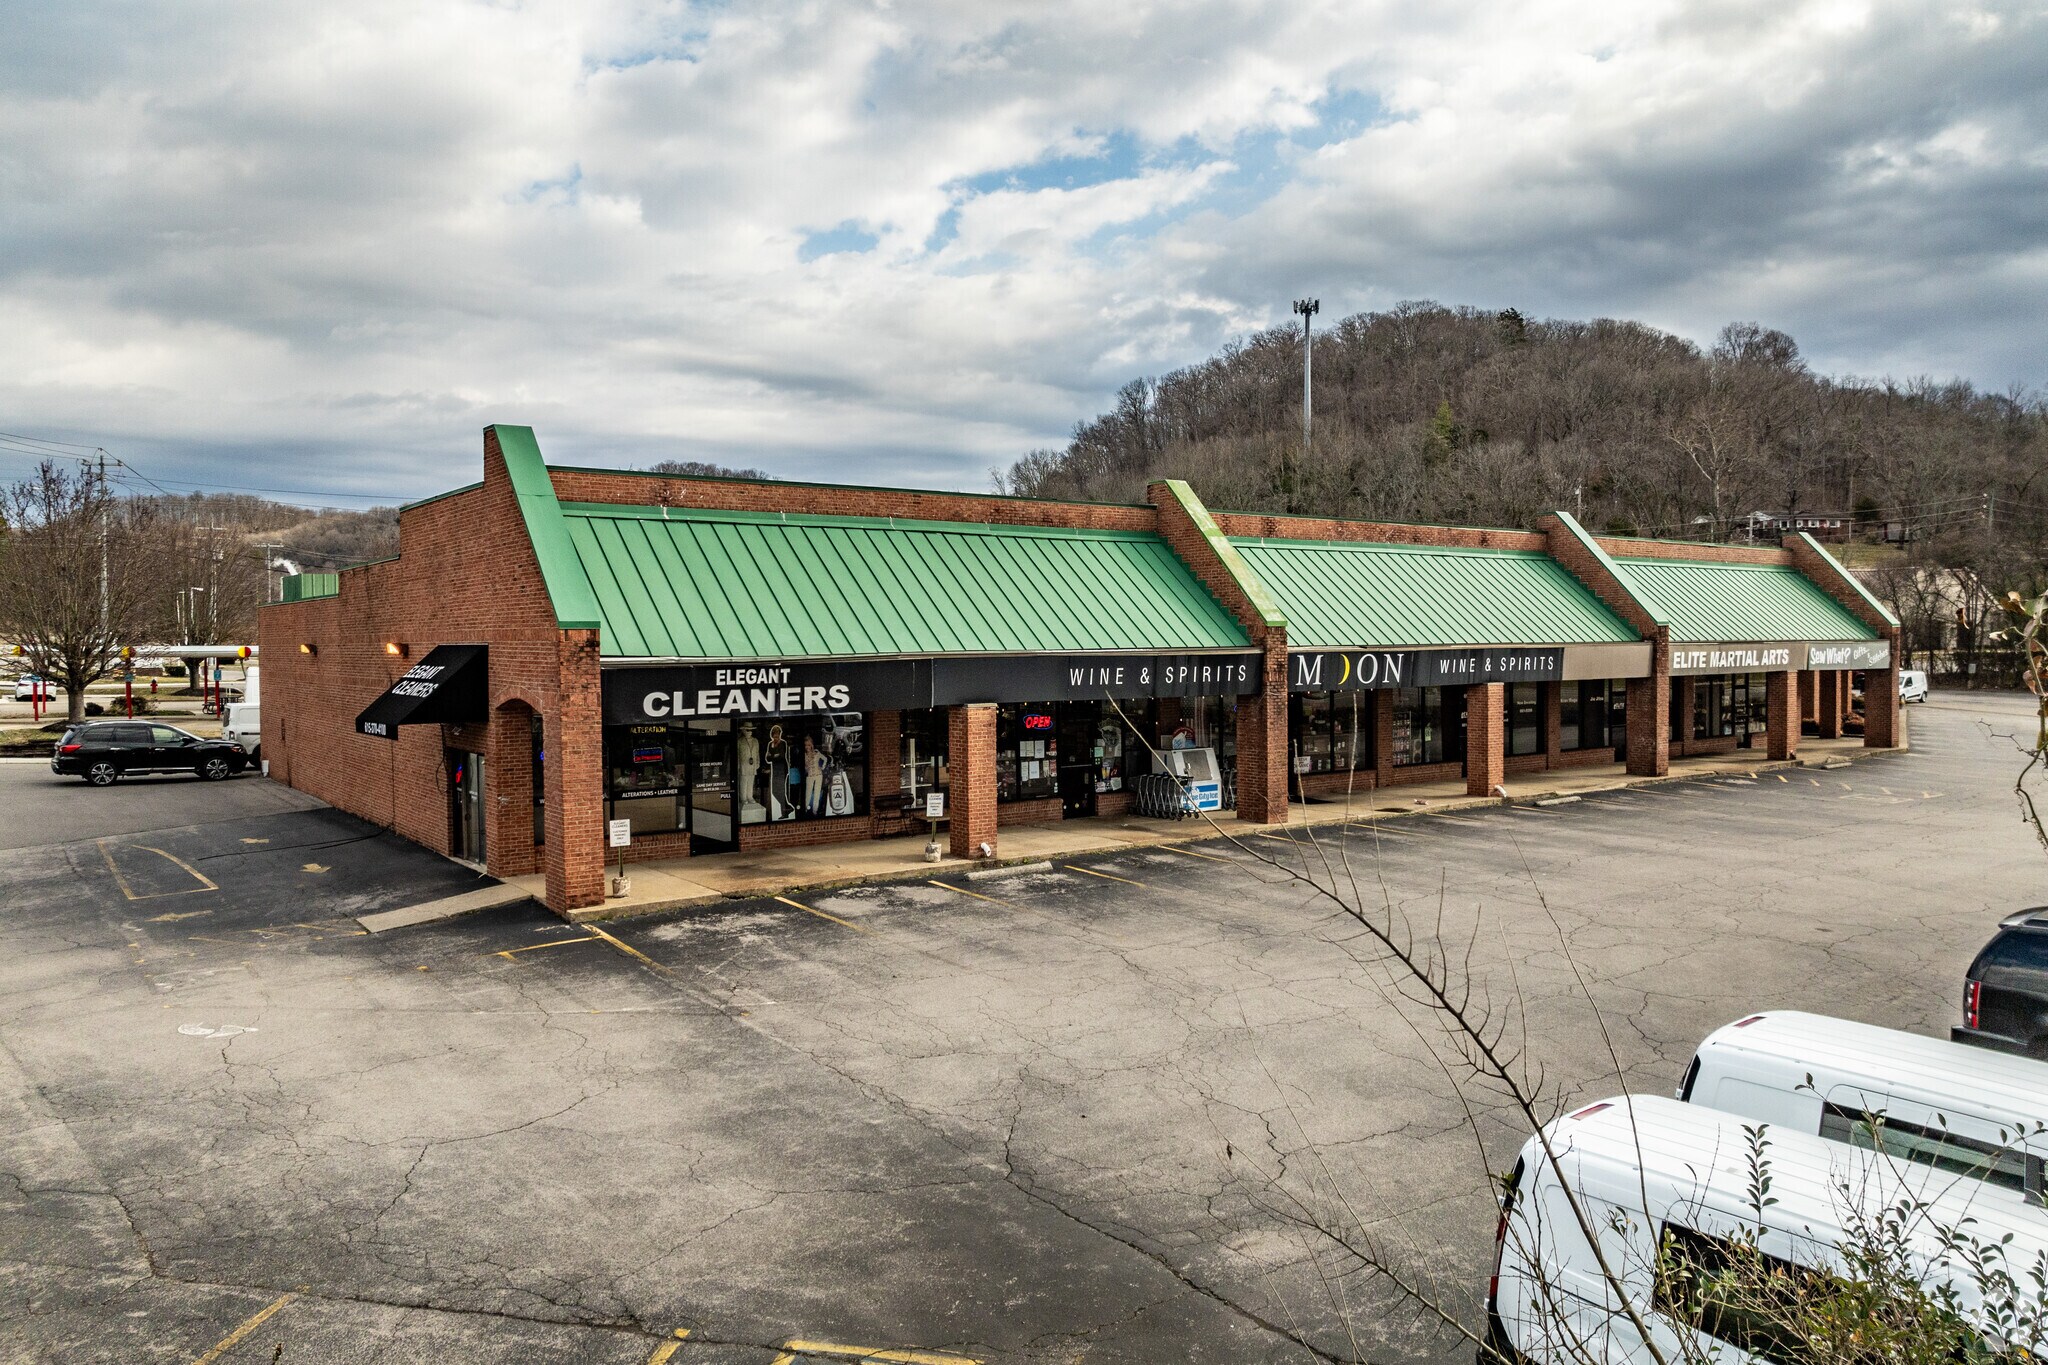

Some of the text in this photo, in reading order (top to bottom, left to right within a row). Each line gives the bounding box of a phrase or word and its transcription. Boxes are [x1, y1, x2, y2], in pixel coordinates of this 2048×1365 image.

[1673, 648, 1790, 668] ELITE MARTIAL ARTS
[1810, 646, 1851, 665] Sew What?
[402, 665, 446, 680] ELEGANT
[1440, 656, 1554, 674] WINE & SPIRITS
[715, 668, 791, 686] ELEGANT
[1069, 665, 1247, 686] WINE & SPIRITS
[391, 680, 440, 698] CLEANERS
[642, 684, 850, 717] CLEANERS
[1025, 715, 1052, 729] OPEN
